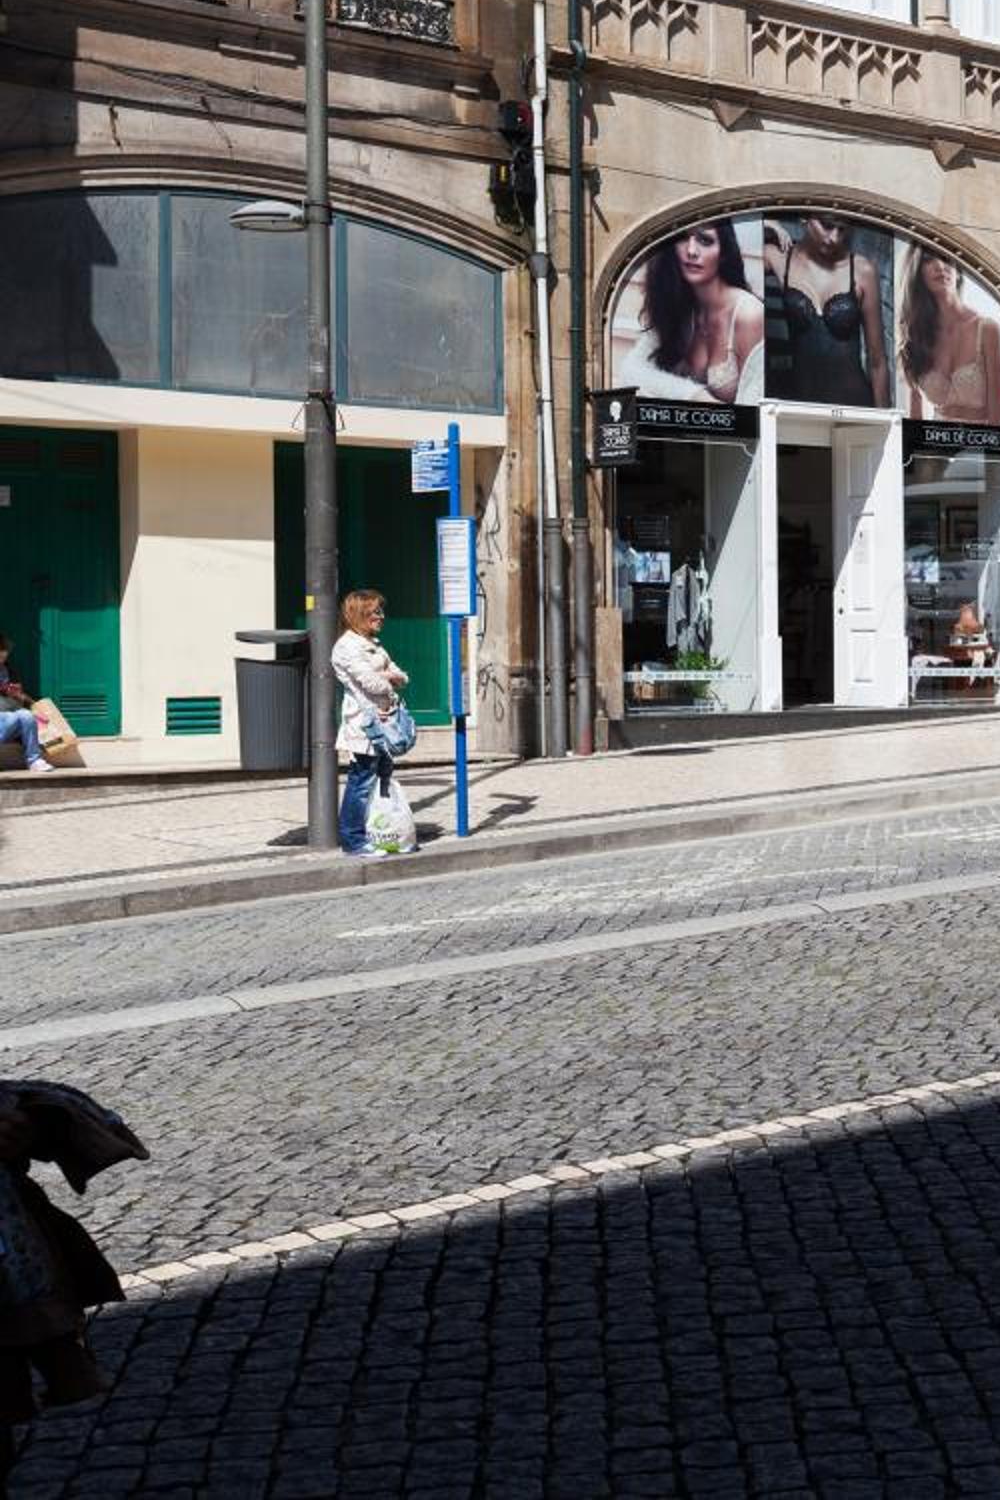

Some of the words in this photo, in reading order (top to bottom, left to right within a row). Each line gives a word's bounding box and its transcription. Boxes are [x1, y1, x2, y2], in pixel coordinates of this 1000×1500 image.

[639, 407, 671, 422] DAMA
[674, 409, 689, 423] DE
[925, 429, 951, 443] DAMA
[953, 430, 966, 444] DE
